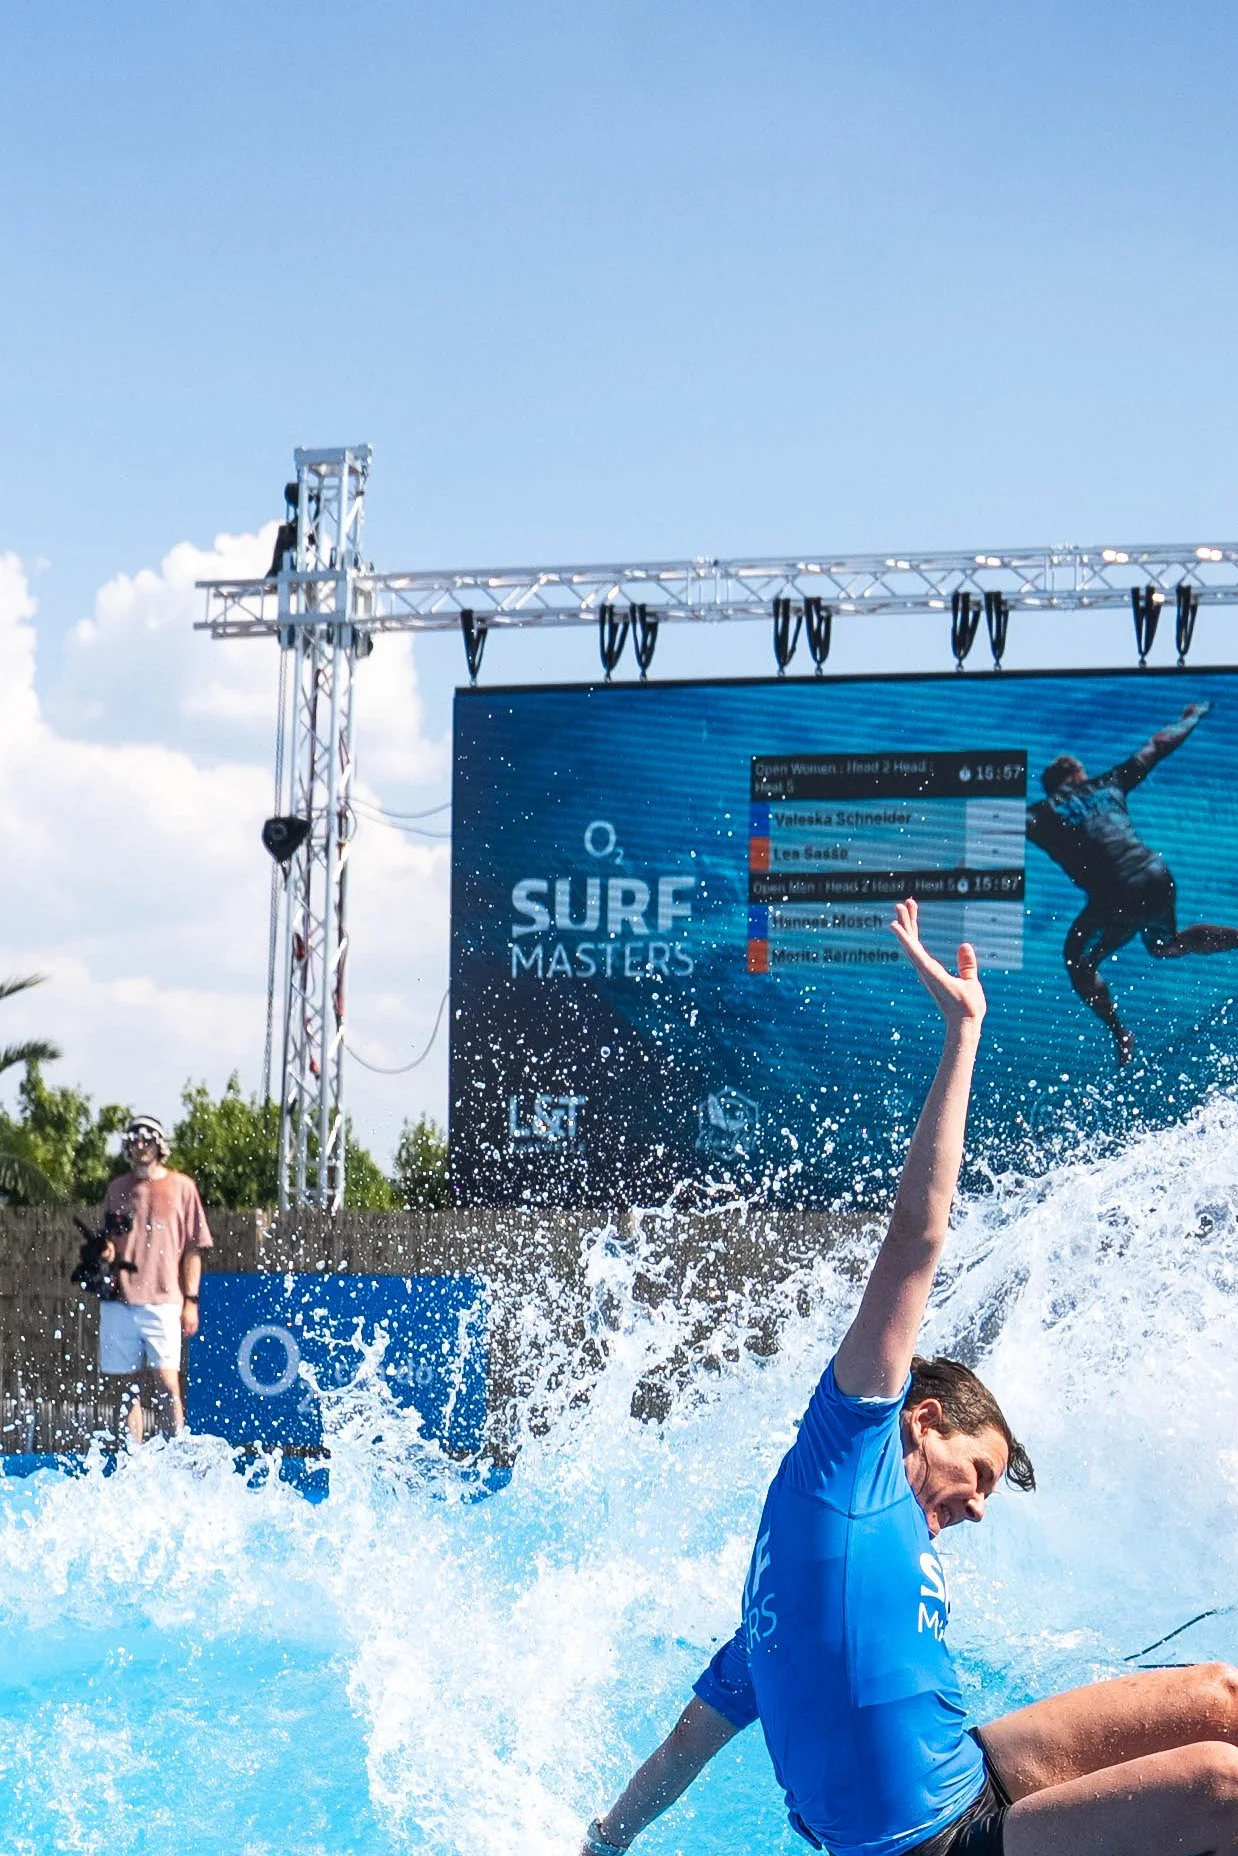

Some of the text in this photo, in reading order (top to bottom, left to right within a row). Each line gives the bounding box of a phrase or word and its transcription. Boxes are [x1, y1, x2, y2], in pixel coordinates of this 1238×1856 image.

[756, 762, 788, 777] Open
[791, 761, 837, 775] Women
[847, 759, 880, 774] Head
[882, 760, 890, 773] 2
[893, 758, 926, 773] Head
[755, 780, 783, 794] Heat
[775, 809, 911, 827] Valeska Schneider
[774, 846, 849, 861] Lea Sasse
[753, 882, 786, 895] Open
[789, 879, 816, 893] Men
[825, 878, 858, 892] Head
[873, 876, 904, 891] Head
[915, 875, 943, 890] Heat
[511, 876, 696, 939] SURF
[772, 914, 829, 930] Hannes
[511, 941, 695, 979] MASTERS
